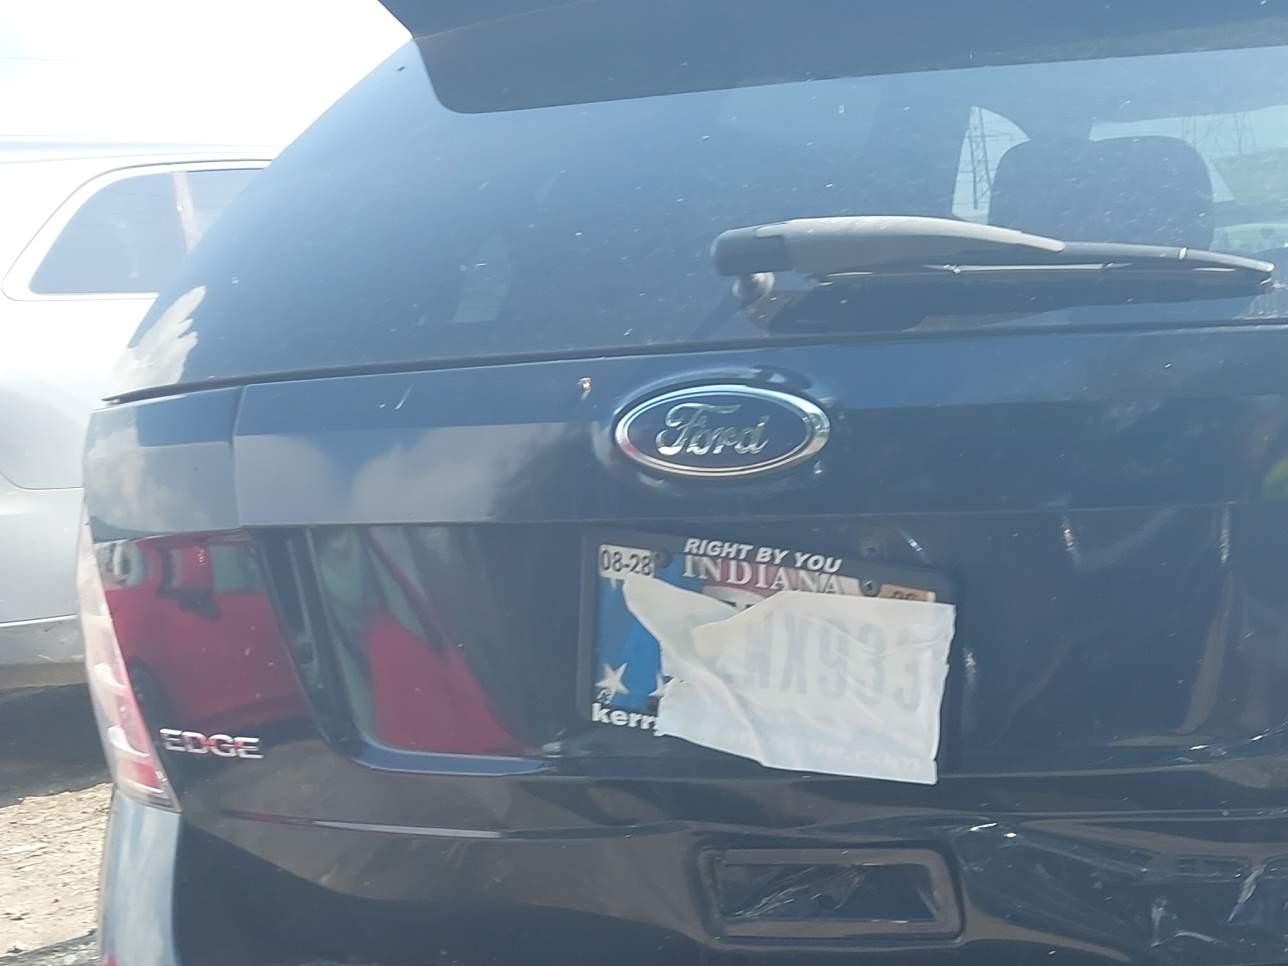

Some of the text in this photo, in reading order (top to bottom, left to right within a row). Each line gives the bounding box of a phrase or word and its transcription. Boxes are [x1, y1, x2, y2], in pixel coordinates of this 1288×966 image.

[656, 402, 770, 456] Ford
[684, 537, 842, 573] RIGHT BY YOU
[682, 555, 843, 594] INDIANA
[160, 728, 264, 759] EDGE
